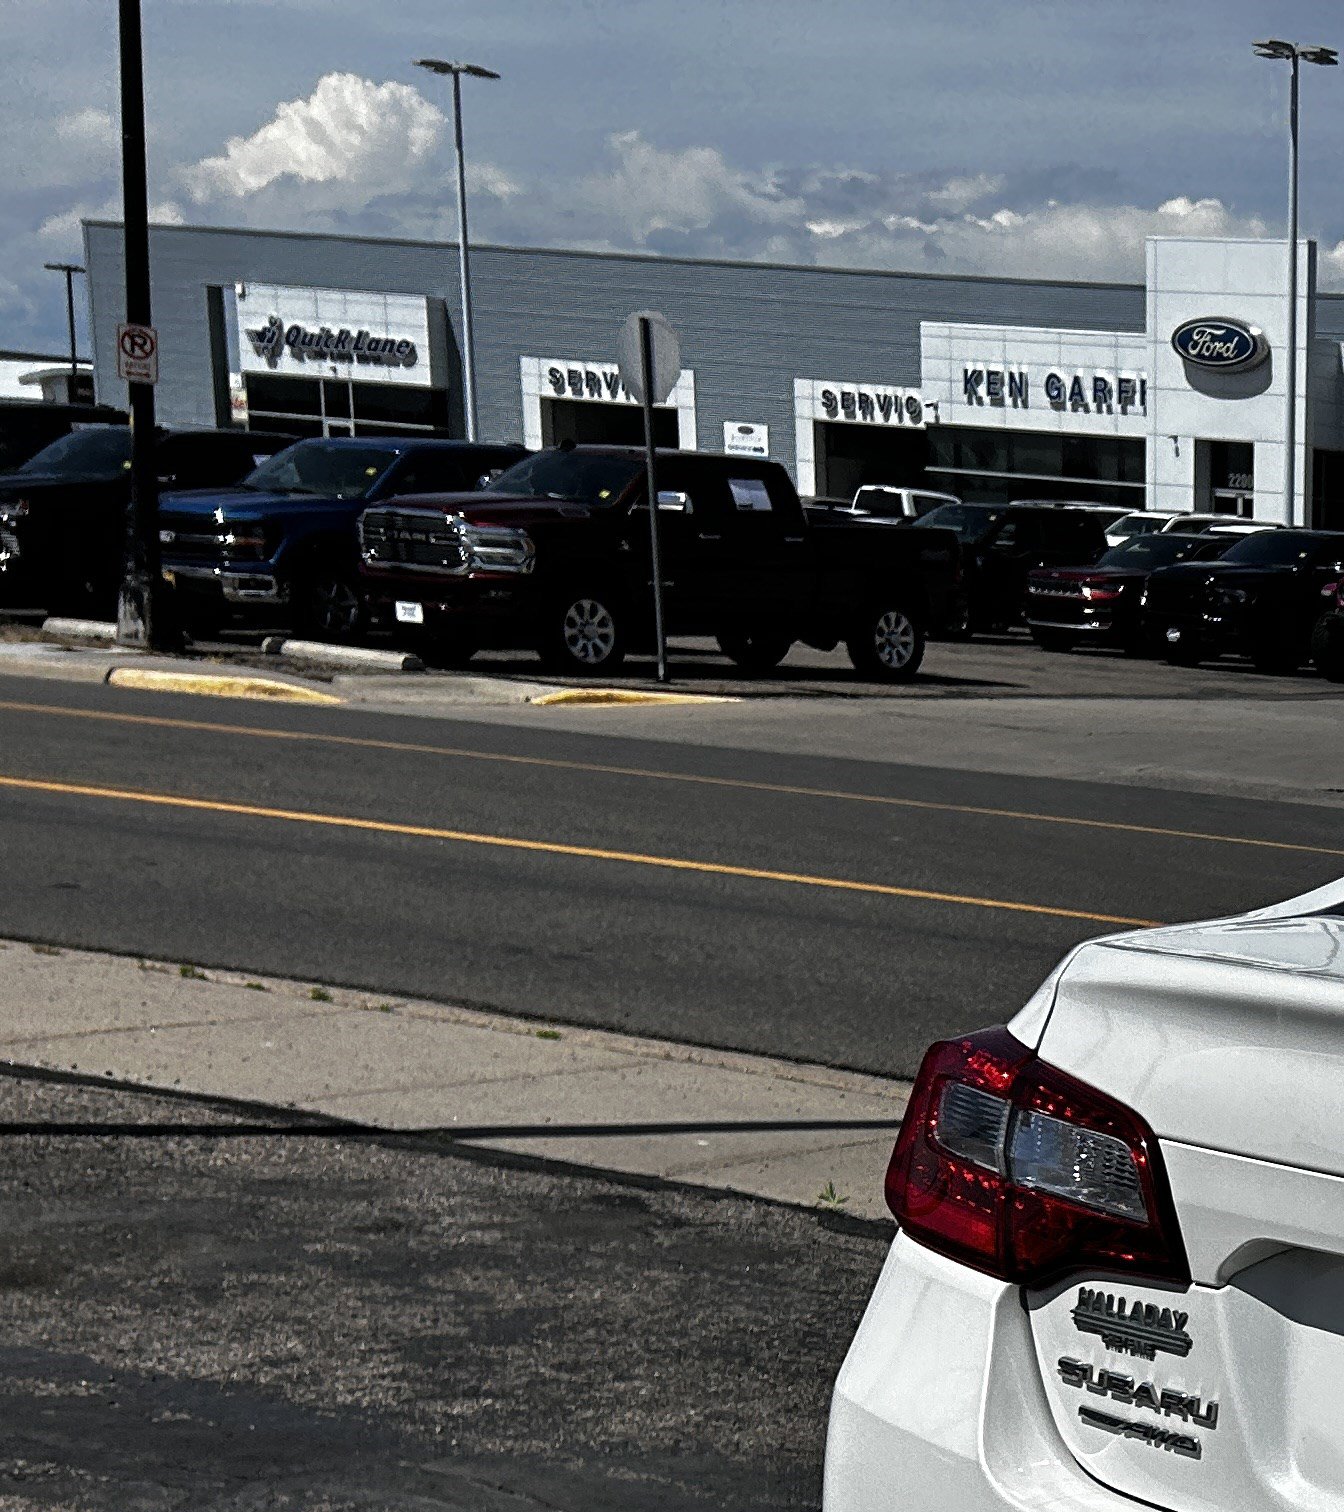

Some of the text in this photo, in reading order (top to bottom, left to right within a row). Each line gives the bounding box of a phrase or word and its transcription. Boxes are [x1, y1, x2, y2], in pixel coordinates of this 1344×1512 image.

[285, 324, 415, 355] Quick Lane
[1188, 326, 1239, 359] Ford
[963, 368, 1026, 399] KEN
[1078, 1286, 1189, 1332] HALLADAY
[1056, 1356, 1220, 1431] SUBARU
